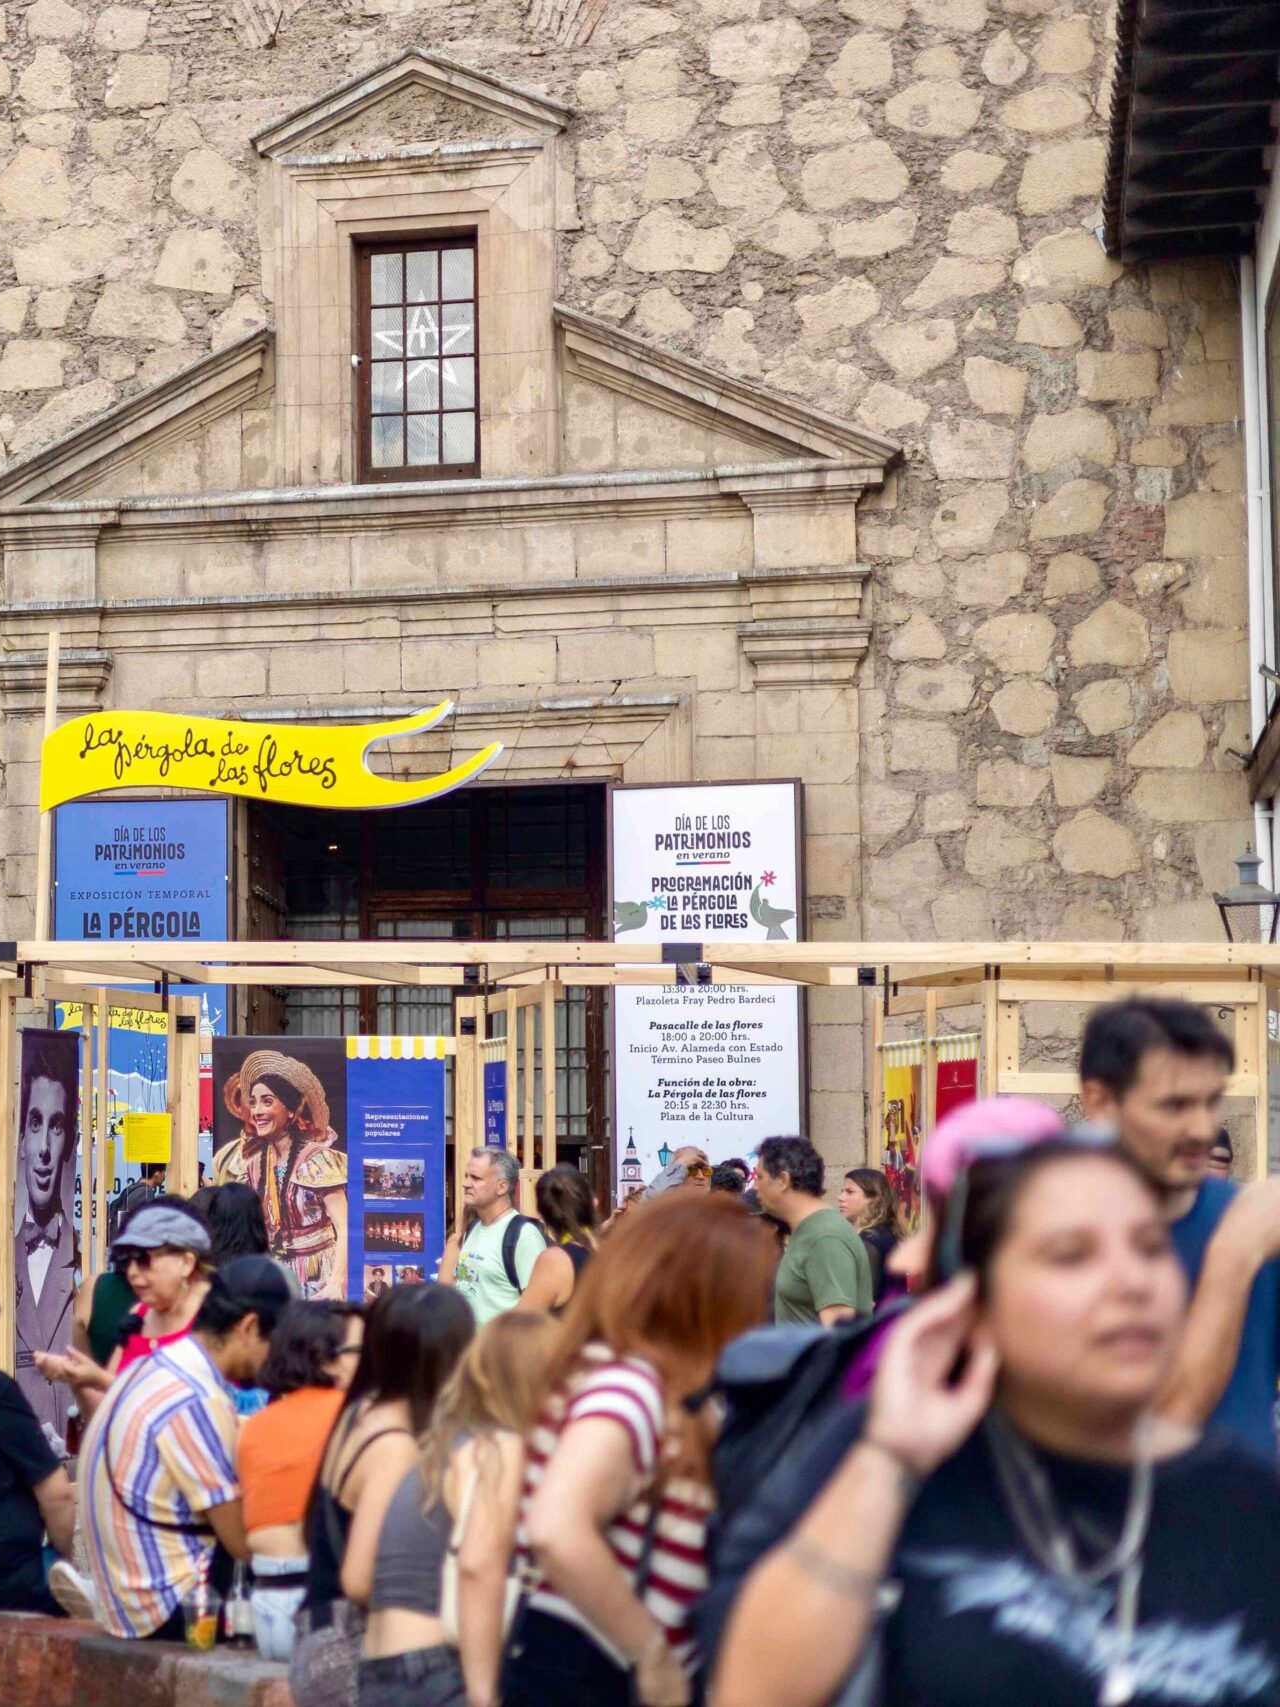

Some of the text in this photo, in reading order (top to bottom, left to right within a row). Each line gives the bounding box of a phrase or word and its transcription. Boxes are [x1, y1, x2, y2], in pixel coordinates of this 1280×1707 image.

[80, 723, 249, 780] la pérgola de
[209, 734, 337, 793] las flores
[675, 813, 730, 831] DÍA DE LOS
[114, 825, 166, 842] DÍA DE LOS
[676, 851, 730, 860] en verano
[115, 861, 165, 870] en verano
[651, 871, 752, 892] PROGRAMACIÓN
[70, 889, 211, 900] EXPOSICIÓN TEMPORAL
[667, 892, 738, 911] LA PÉRGOLA
[83, 906, 200, 938] LA PÉRGOLA
[660, 913, 748, 930] DE LAS FLORES
[698, 985, 726, 994] 20:00
[730, 985, 749, 993] hrs.
[636, 996, 680, 1005] Plazoleta
[682, 996, 704, 1007] Fray
[707, 995, 736, 1004] Pedro
[649, 1020, 763, 1031] Pasacalle de las flores
[662, 1032, 687, 1041] 18:00
[699, 1032, 727, 1041] 20:00
[731, 1032, 750, 1041] hrs.
[630, 1044, 658, 1053] Inicio
[661, 1044, 677, 1053] Av.
[681, 1043, 725, 1052] Alameda
[750, 1043, 783, 1052] Estado
[651, 1054, 761, 1064] Término Paseo Bulnes
[658, 1078, 757, 1087] Función de la obra:
[648, 1088, 767, 1100] La Pérgola de las flores
[664, 1101, 689, 1109] 20:15
[701, 1101, 727, 1109] 22:30
[730, 1101, 749, 1109] hrs.
[660, 1112, 754, 1121] Plaza de la Cultura
